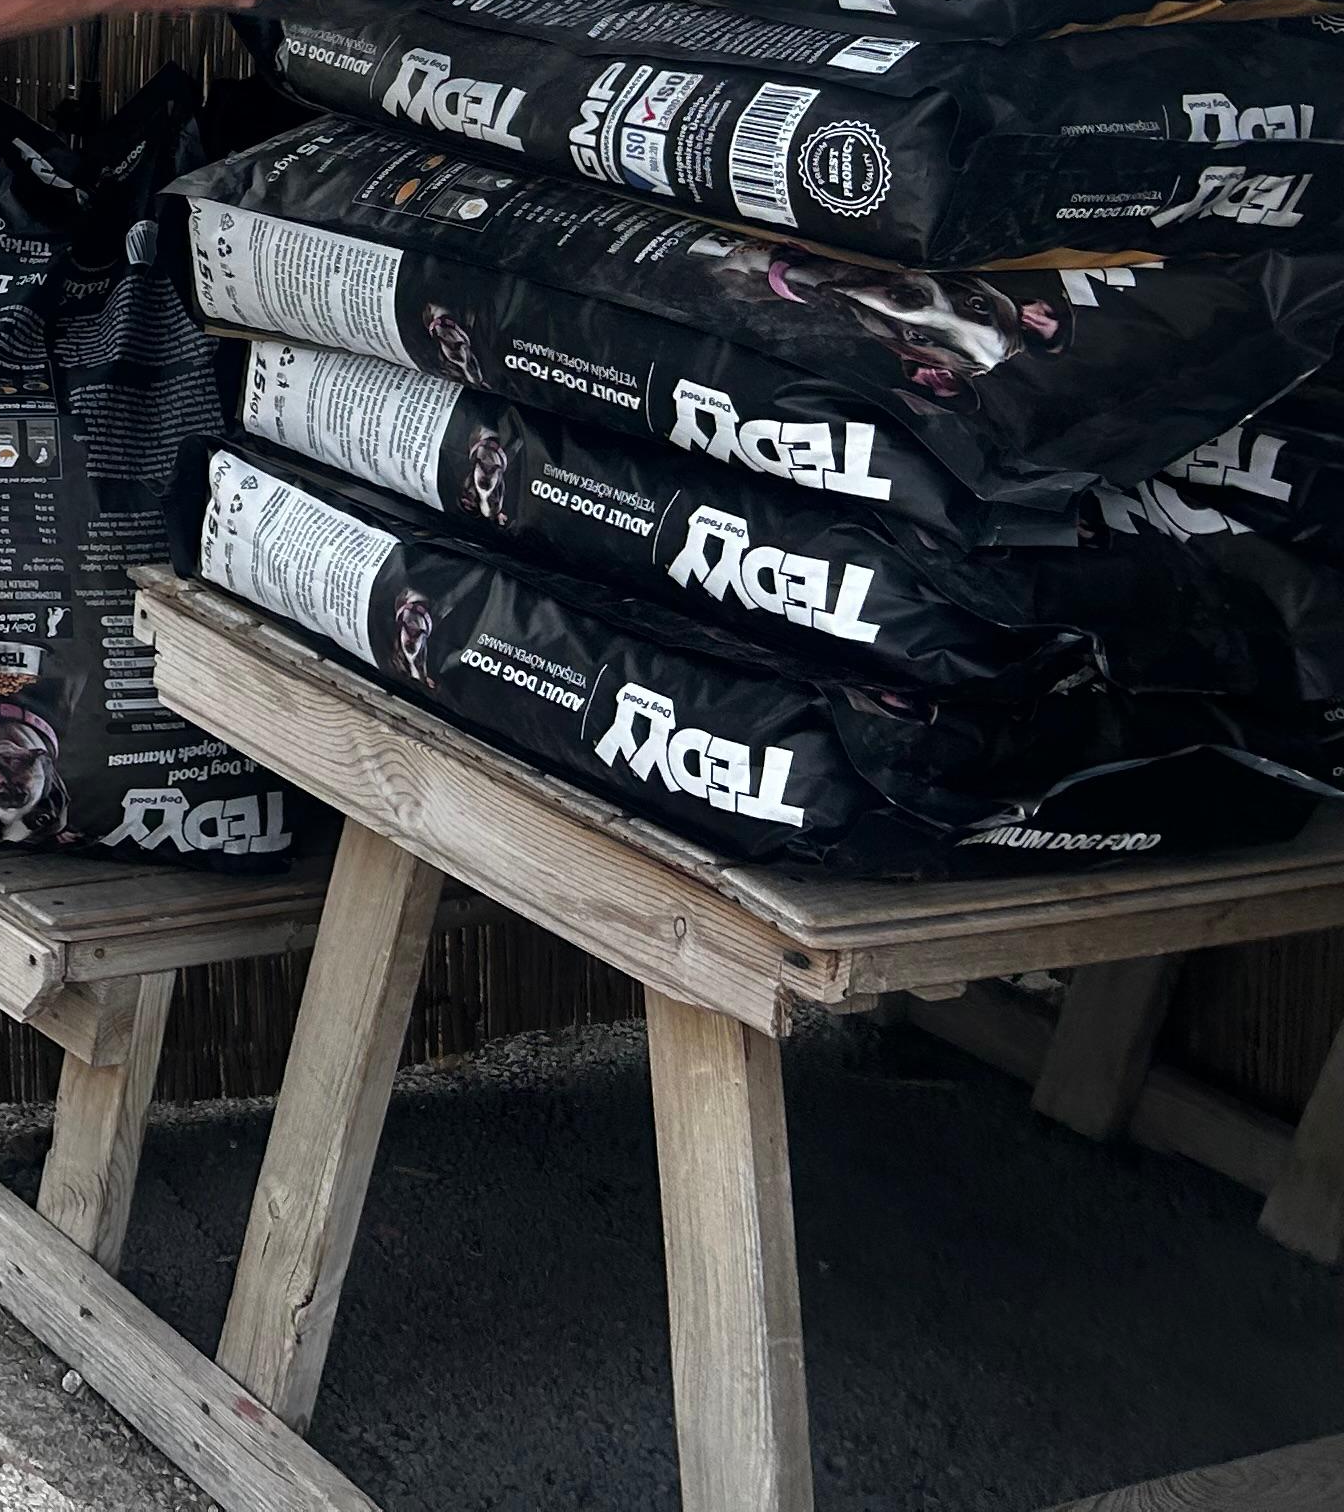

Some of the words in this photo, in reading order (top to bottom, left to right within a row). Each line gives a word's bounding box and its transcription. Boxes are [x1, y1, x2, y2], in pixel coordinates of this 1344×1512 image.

[308, 44, 336, 66] DOG
[334, 51, 374, 76] ADULT
[431, 59, 448, 72] Dog
[382, 47, 528, 153] TEDYY
[652, 74, 687, 104] ISO
[569, 61, 626, 182] GMP
[624, 131, 647, 162] ISO
[813, 142, 828, 185] PREMIUM
[827, 148, 841, 185] BEST
[842, 136, 857, 198] PRODUCT
[861, 153, 874, 193] QUALITY
[772, 151, 788, 206] 683851
[1056, 207, 1092, 219] FOOD
[1092, 206, 1122, 219] DOG
[254, 351, 268, 394] 15
[504, 354, 550, 380] FOOD
[556, 353, 592, 374] KÖPEK
[591, 363, 639, 388] YETİŞKİN
[551, 369, 589, 392] DOG
[590, 387, 642, 411] ADULT
[680, 389, 707, 406] Food
[709, 397, 732, 413] Dog
[667, 378, 893, 501] TEDYY
[530, 479, 570, 507] FOOD
[611, 490, 656, 514] YETİŞKİN
[570, 496, 606, 522] DOG
[605, 512, 655, 538] ADULT
[696, 515, 723, 532] Food
[723, 521, 746, 539] Dog
[667, 503, 881, 645] TEDYY
[11, 622, 37, 633] Daily
[461, 647, 502, 677] FOOD
[512, 651, 545, 673] KÖPEK
[502, 666, 537, 691] DOG
[543, 662, 587, 689] YETİŞKİN
[537, 682, 586, 713] ADULT
[622, 691, 649, 710] Food
[650, 701, 672, 719] Dog
[107, 748, 177, 769] Maması
[176, 743, 230, 764] Köpek
[594, 682, 805, 828] TEDYY
[168, 766, 208, 786] Food
[207, 761, 243, 782] Dog
[129, 796, 154, 807] Food
[154, 795, 184, 806] Dog
[99, 788, 293, 855] TEDYY
[1047, 832, 1100, 850] DOG
[1097, 833, 1162, 851] FOOD
